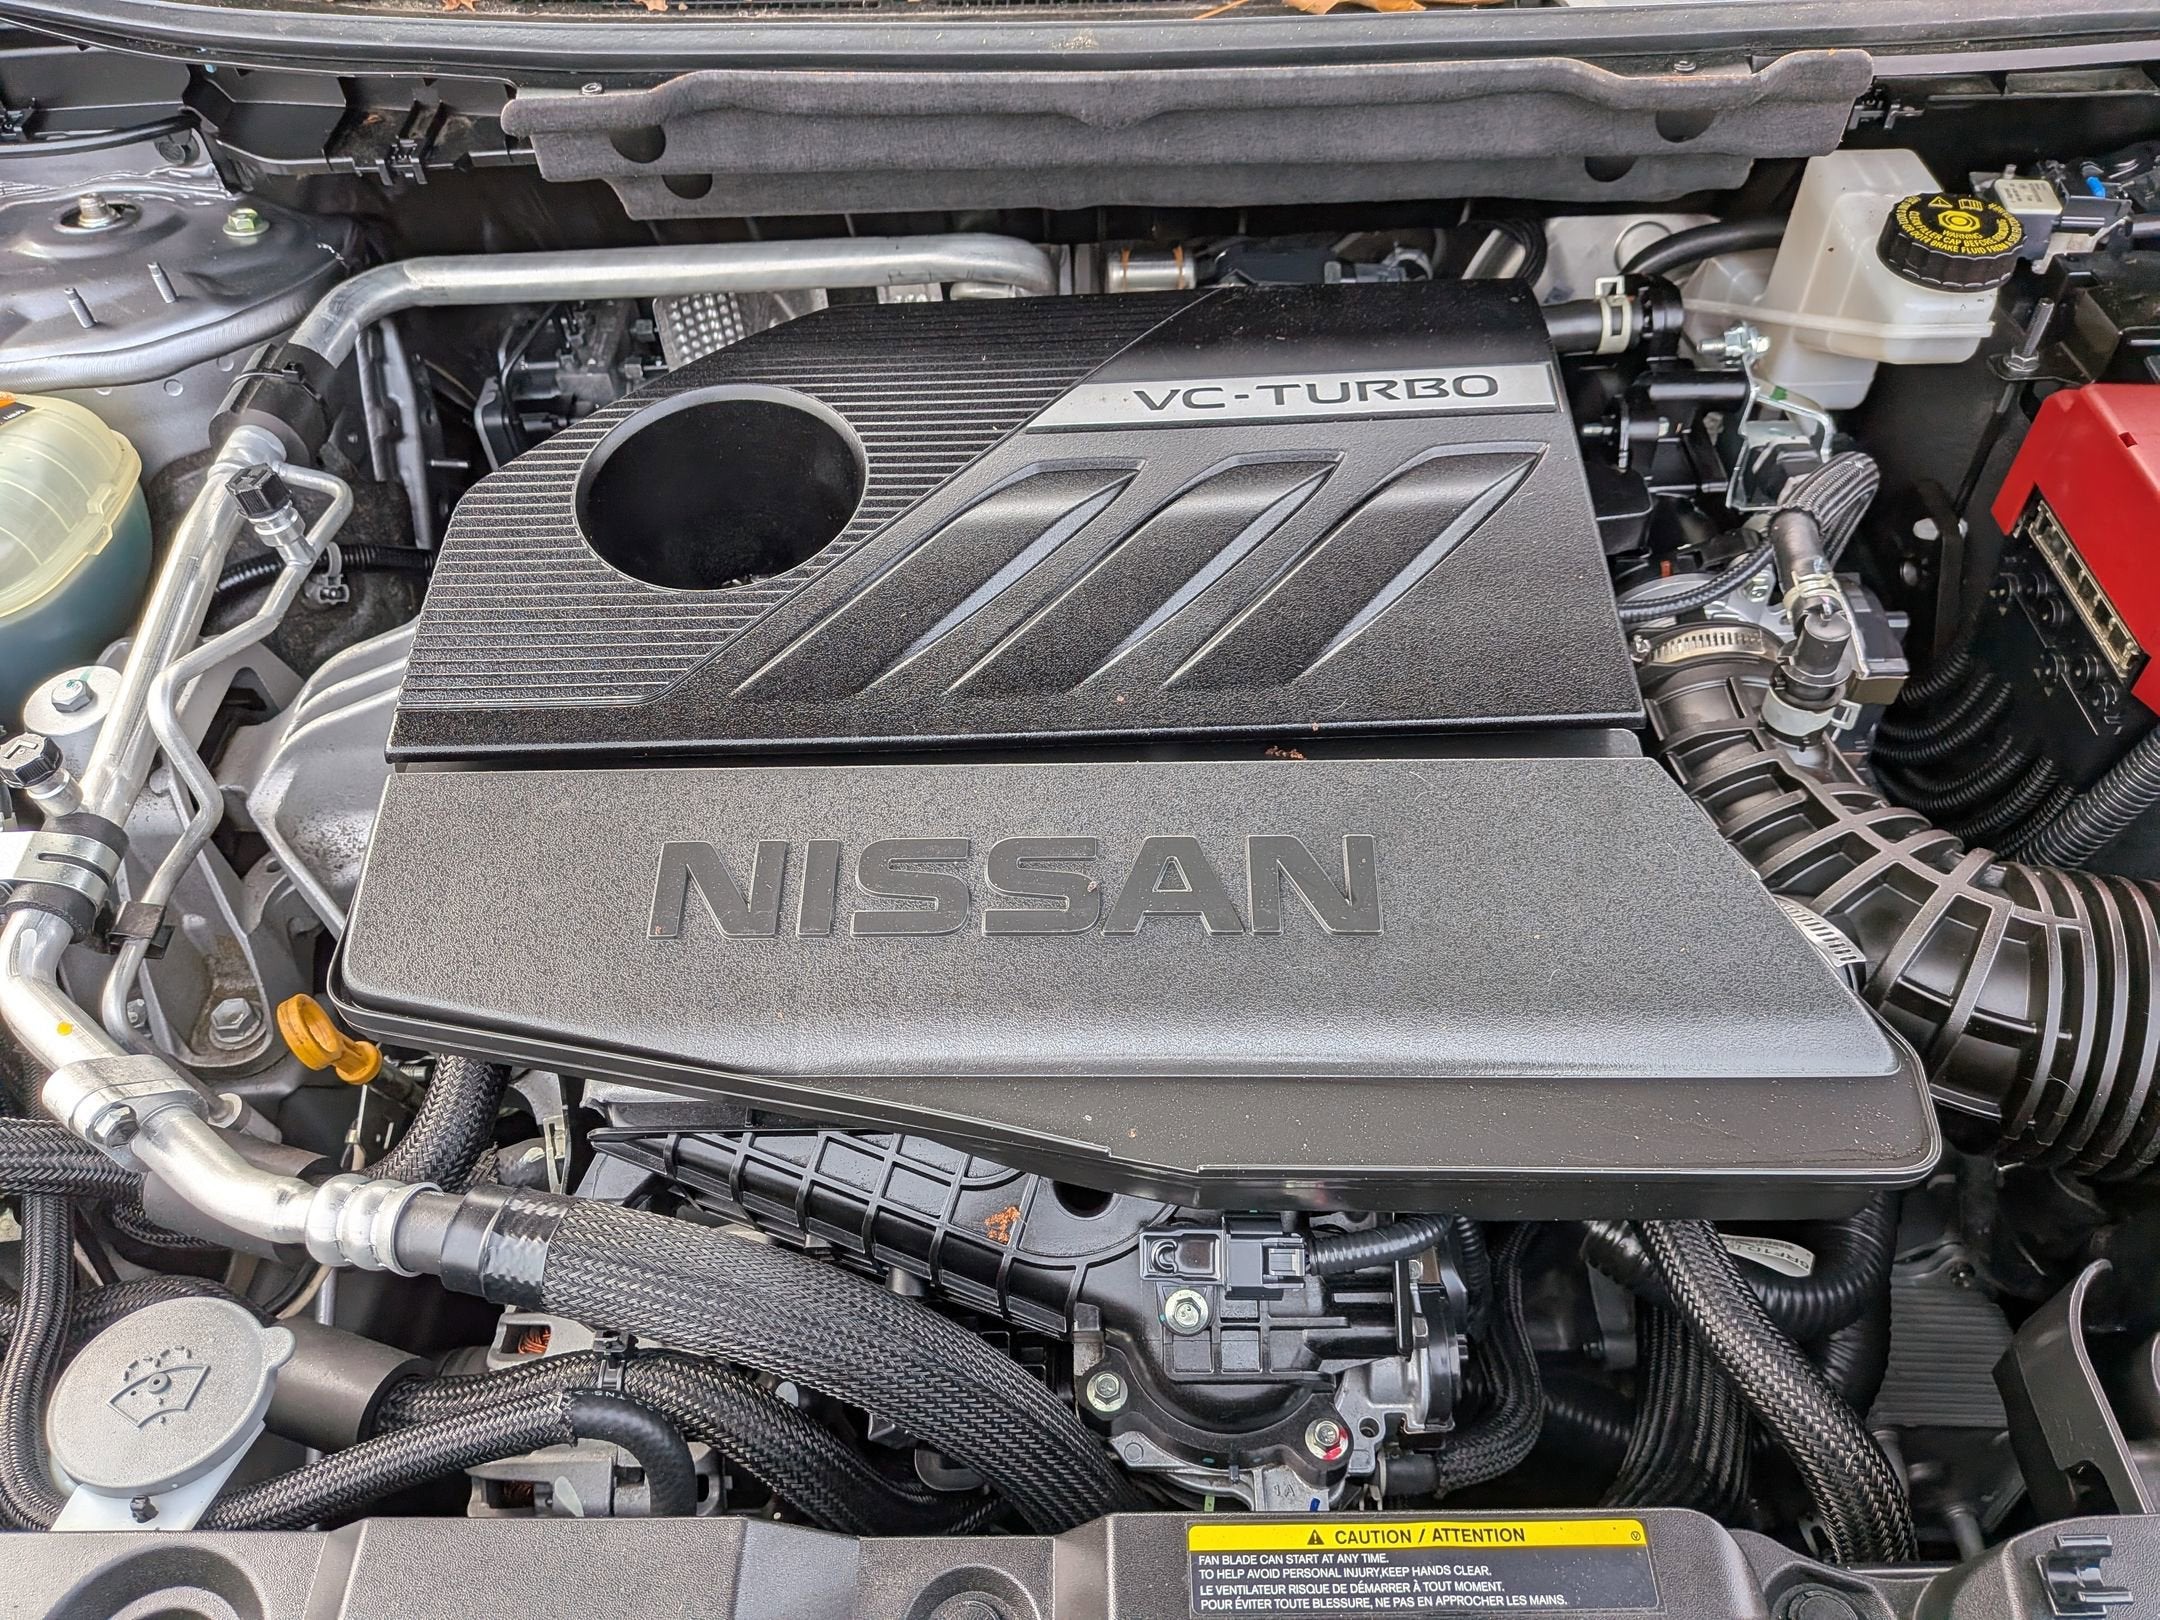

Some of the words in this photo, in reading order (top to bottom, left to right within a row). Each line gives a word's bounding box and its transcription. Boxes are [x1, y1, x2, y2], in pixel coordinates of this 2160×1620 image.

[1943, 230, 1983, 239] WARNING
[1946, 235, 1962, 245] CAP
[1964, 238, 1994, 247] BEFORE
[1930, 240, 1959, 252] BRAKE
[1961, 246, 1986, 255] FLUID
[1133, 373, 1498, 412] VC-TURBO
[646, 834, 1385, 939] NISSAN
[1335, 1529, 1412, 1545] CAUTION
[1418, 1529, 1425, 1543] /
[1432, 1528, 1525, 1543] ATTENTION
[1199, 1556, 1220, 1565] FAN
[1222, 1555, 1257, 1565] BLADE
[1260, 1555, 1283, 1565] CAN
[1286, 1554, 1320, 1564] START
[1322, 1554, 1334, 1564] AT
[1337, 1554, 1361, 1564] ANY
[1361, 1553, 1389, 1564] TIME.
[1199, 1570, 1214, 1579] TO
[1217, 1569, 1244, 1579] HELP
[1246, 1569, 1280, 1579] AVOID
[1283, 1568, 1341, 1578] PERSONAL
[1411, 1565, 1451, 1577] HANDS
[1454, 1565, 1491, 1576] CLEAR.
[1200, 1585, 1213, 1595] LE
[1215, 1585, 1286, 1595] VENTILATEUR
[1289, 1584, 1329, 1595] RISQUE
[1332, 1583, 1347, 1594] DE
[1350, 1580, 1410, 1594] DÉMARRER
[1413, 1580, 1422, 1593] À
[1423, 1582, 1452, 1592] TOUT
[1455, 1581, 1504, 1591] MOMENT.
[1201, 1600, 1232, 1610] POUR
[1235, 1596, 1272, 1610] ÉVITER
[1274, 1599, 1311, 1609] TOUTE
[1314, 1598, 1373, 1610] BLESSURE,
[1375, 1598, 1390, 1608] NE
[1393, 1597, 1415, 1608] PAS
[1417, 1596, 1433, 1606] EN
[1435, 1596, 1504, 1606] APPROCHER
[1507, 1595, 1527, 1605] LES
[1530, 1594, 1568, 1605] MAINS.
